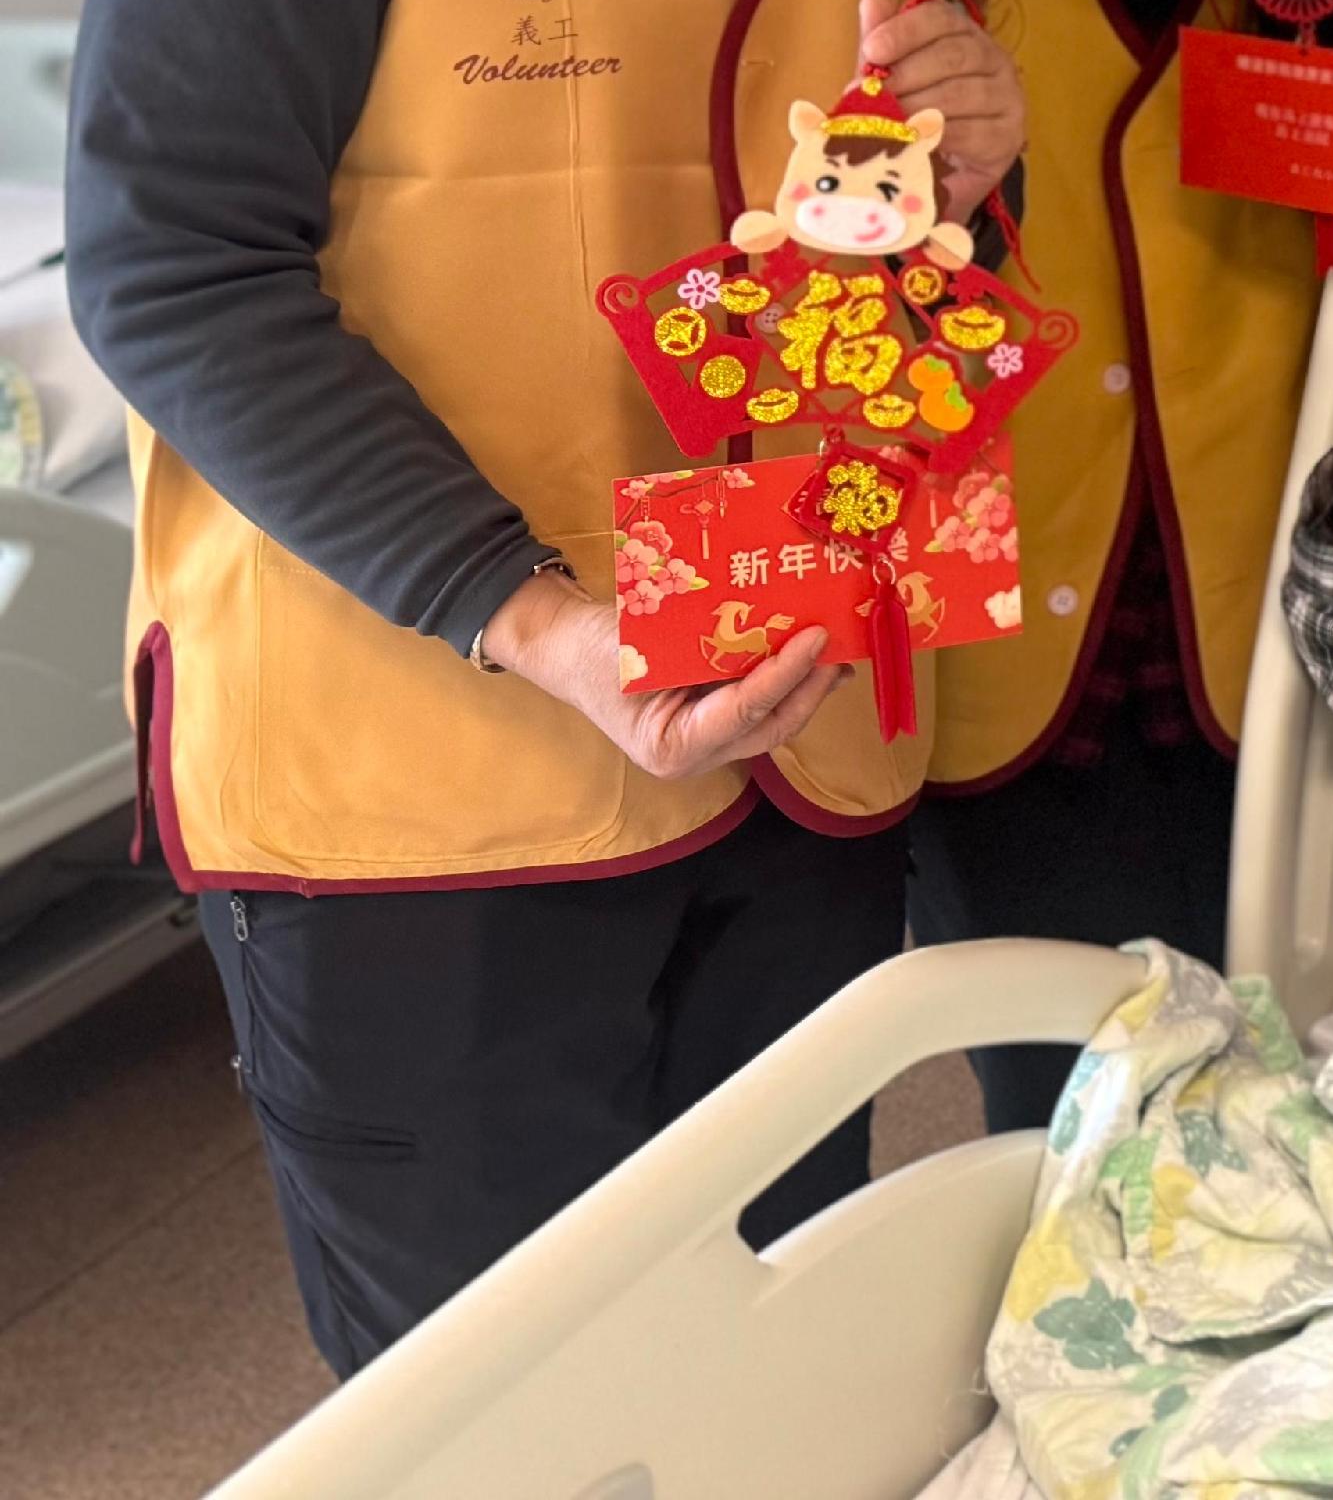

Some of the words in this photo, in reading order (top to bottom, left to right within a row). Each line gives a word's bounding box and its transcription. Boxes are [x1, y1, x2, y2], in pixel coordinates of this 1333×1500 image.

[511, 15, 579, 46] 義工
[453, 54, 622, 85] Volunteer
[777, 269, 903, 396] 福
